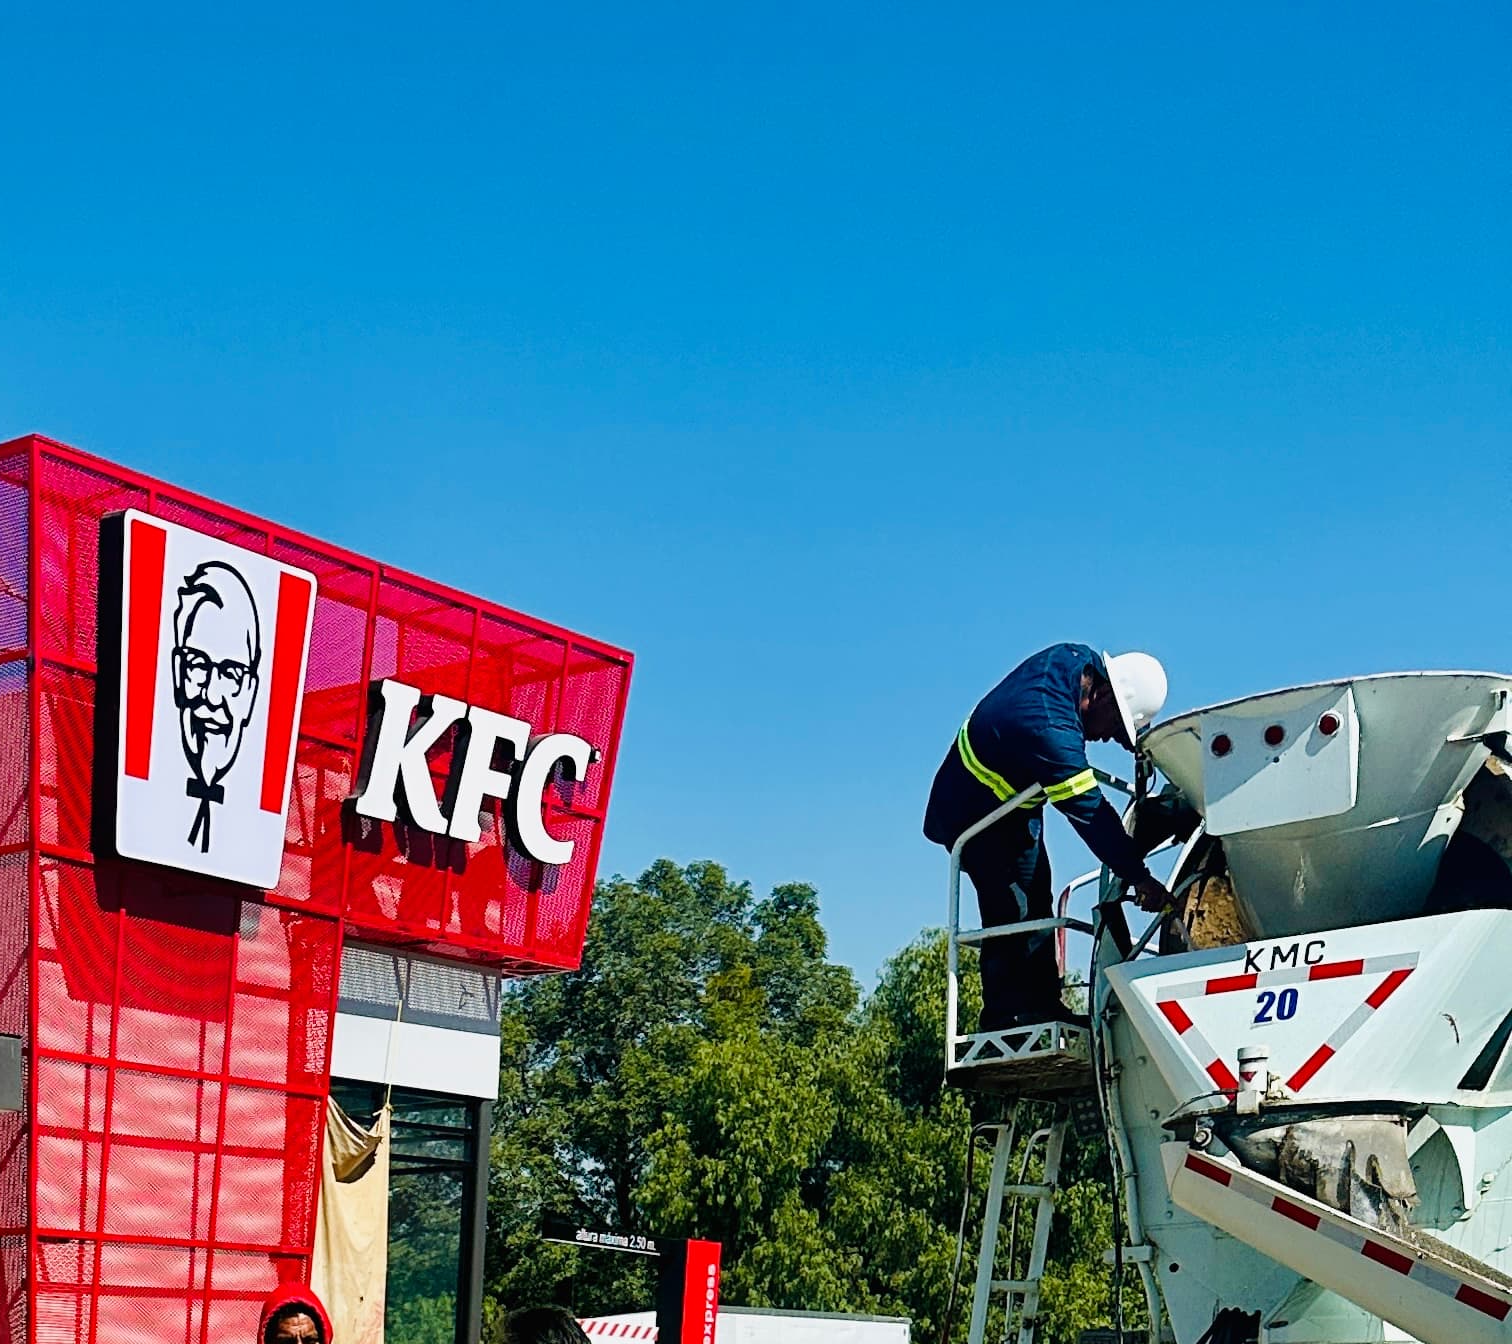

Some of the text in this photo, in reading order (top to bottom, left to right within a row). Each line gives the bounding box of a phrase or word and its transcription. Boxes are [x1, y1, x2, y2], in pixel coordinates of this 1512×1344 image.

[354, 678, 594, 866] KFC
[1244, 940, 1326, 974] KMC
[1253, 988, 1299, 1024] 20
[629, 1234, 647, 1250] 2.50
